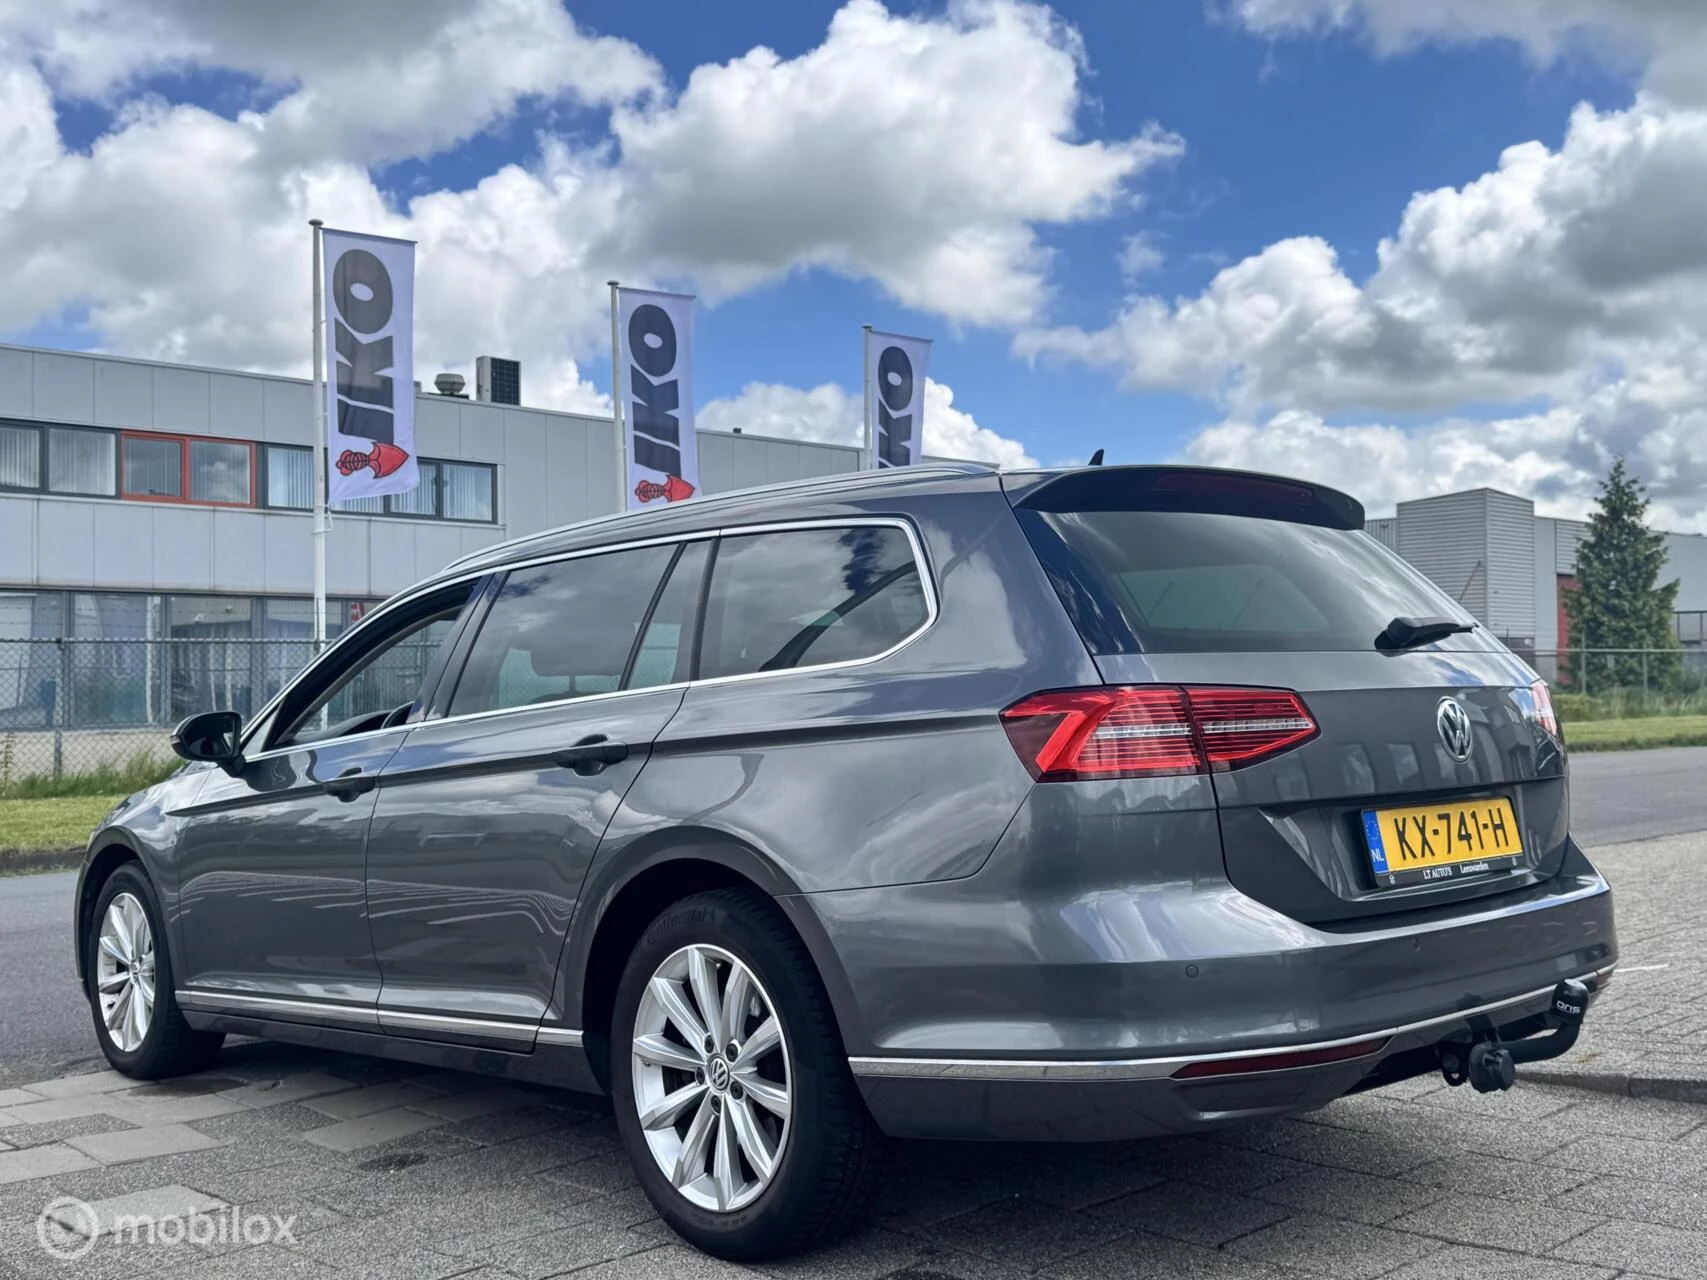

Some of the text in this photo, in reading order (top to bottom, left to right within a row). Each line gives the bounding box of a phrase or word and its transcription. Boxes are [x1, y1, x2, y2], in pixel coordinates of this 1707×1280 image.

[333, 249, 395, 445] IKO
[628, 304, 682, 478] IKO
[878, 346, 913, 469] KO
[1371, 848, 1385, 862] NL
[1393, 808, 1509, 860] KX-741-H
